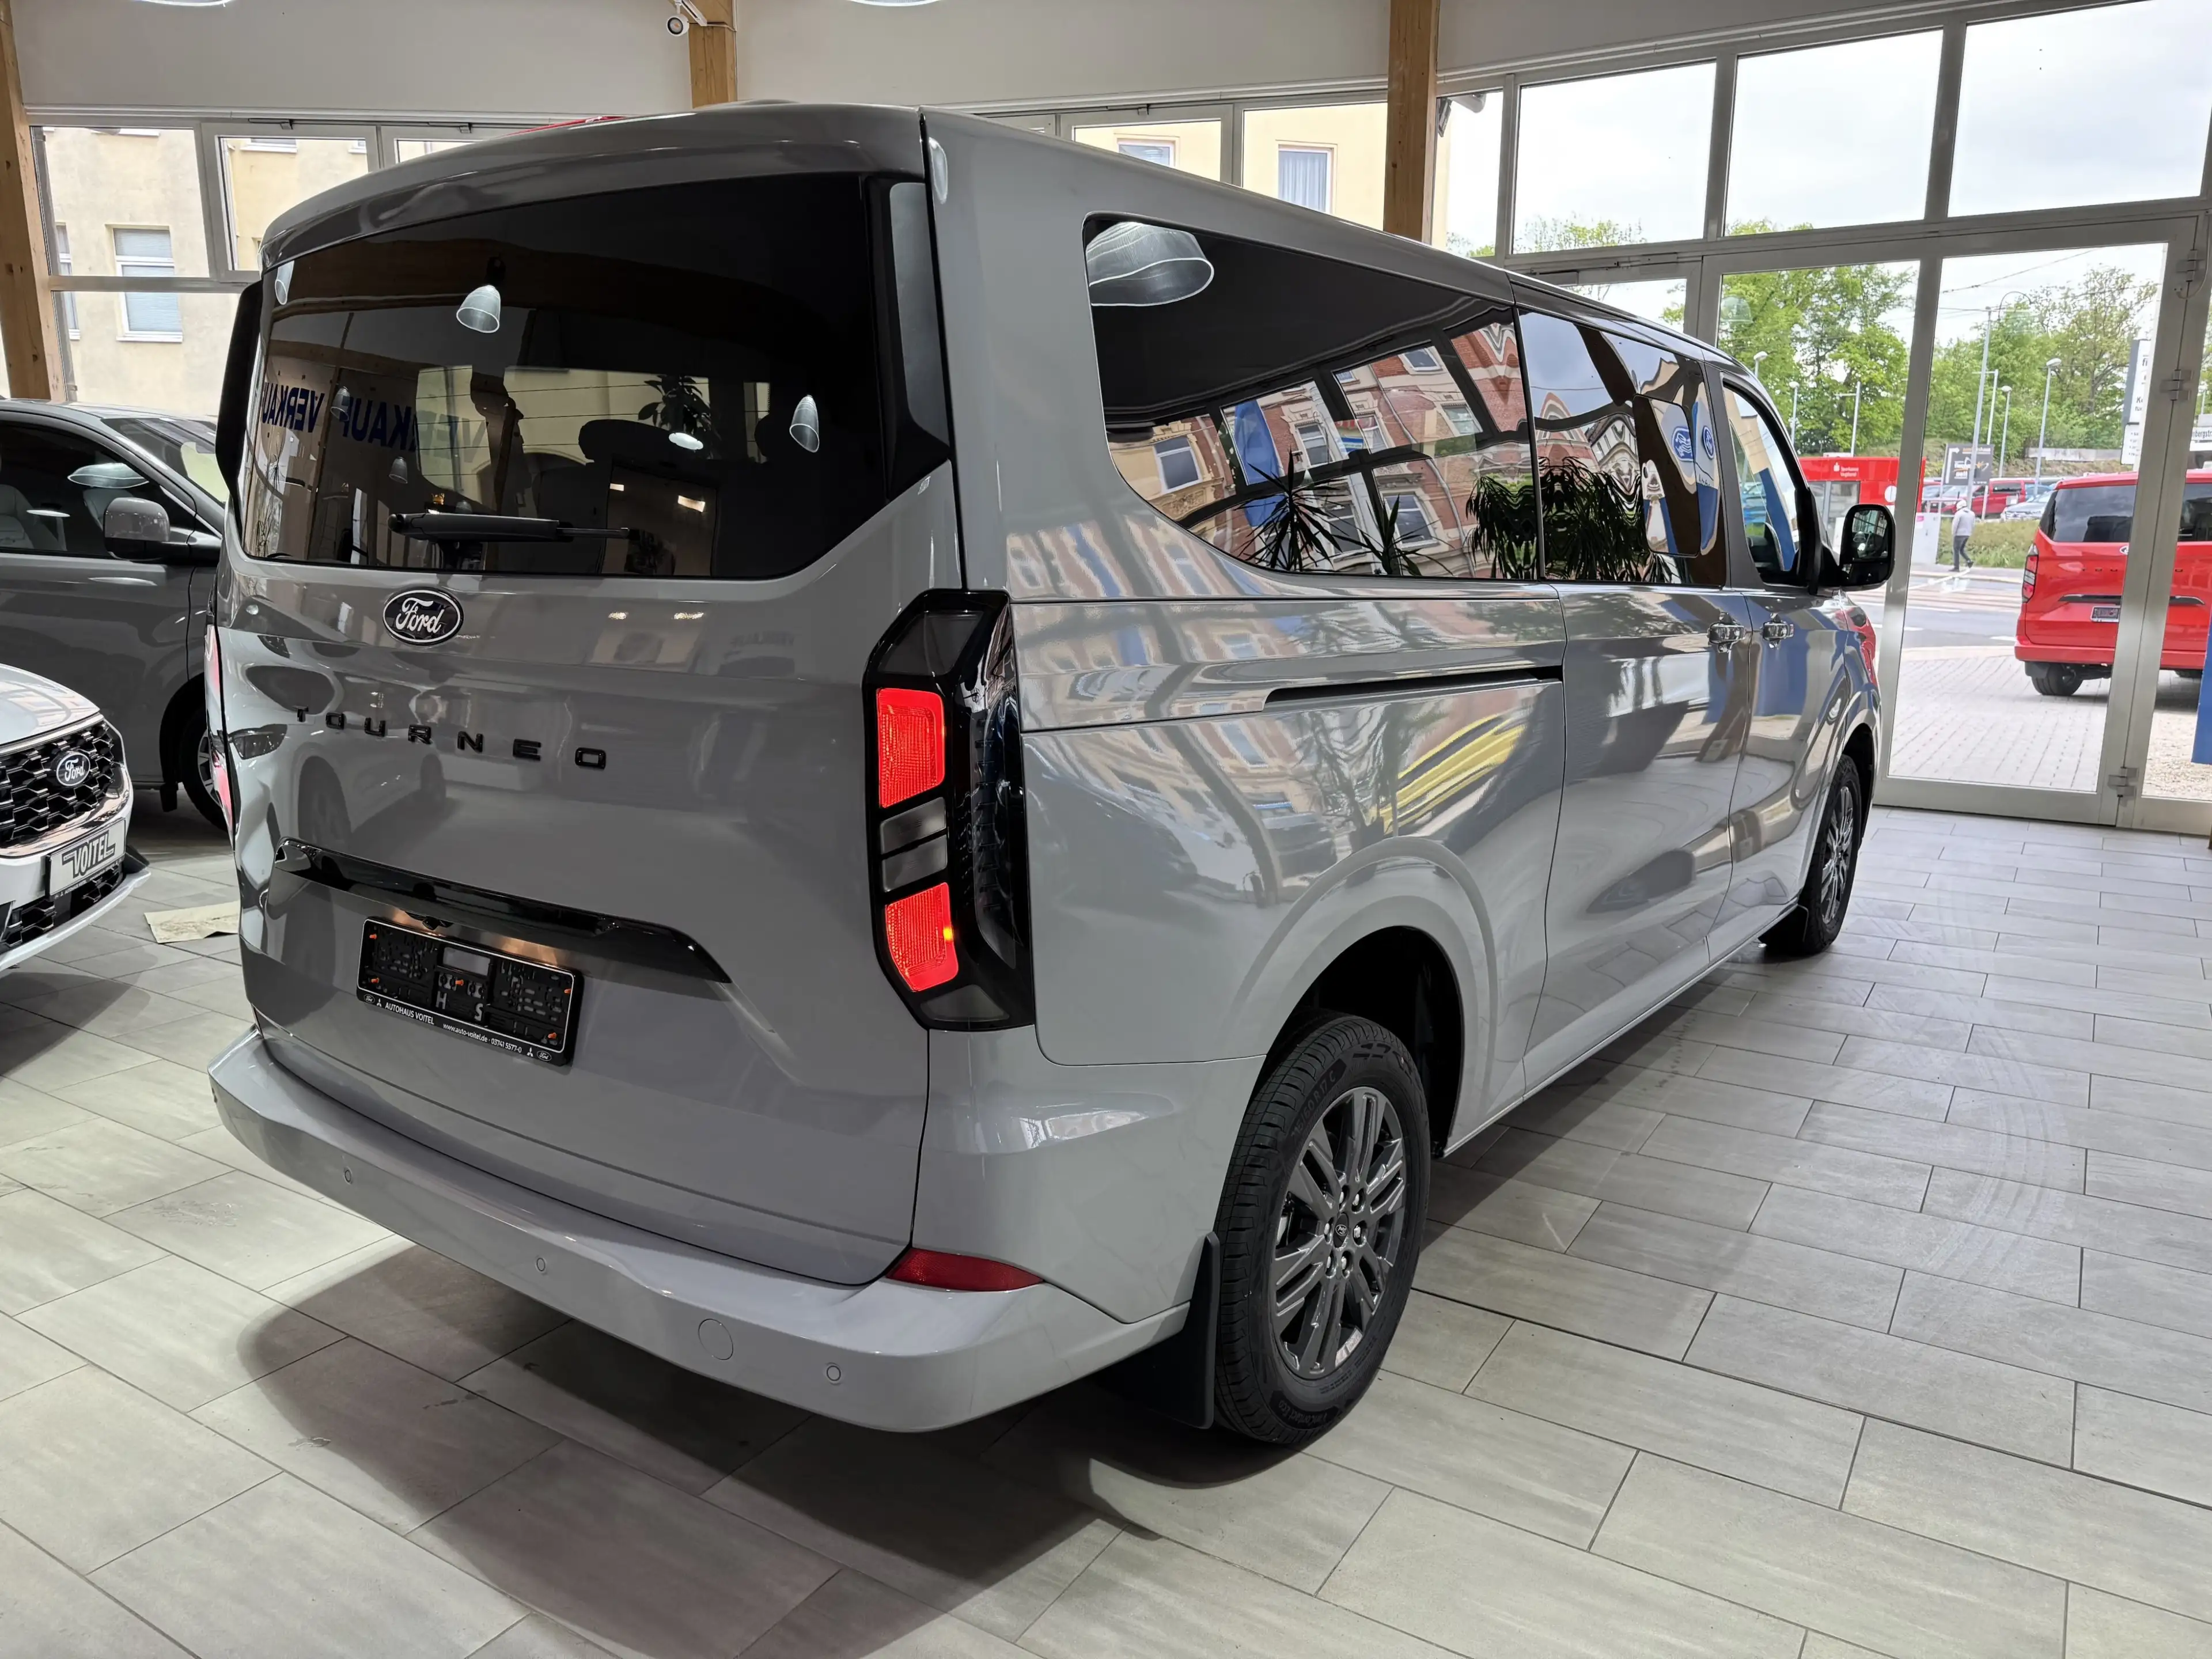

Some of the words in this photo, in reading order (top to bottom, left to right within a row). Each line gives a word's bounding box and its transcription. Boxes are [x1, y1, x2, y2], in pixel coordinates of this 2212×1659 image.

[395, 597, 443, 634] Ford
[292, 705, 607, 770] TOURNEO
[63, 757, 85, 782] Ford
[65, 832, 114, 876] VOITEL
[385, 1001, 415, 1018] AUTOHAUS
[415, 1011, 435, 1025] VOITEL
[443, 1023, 488, 1042] www.auto-voitel.de
[491, 1037, 505, 1048] 03741
[505, 1043, 522, 1054] 5577-0
